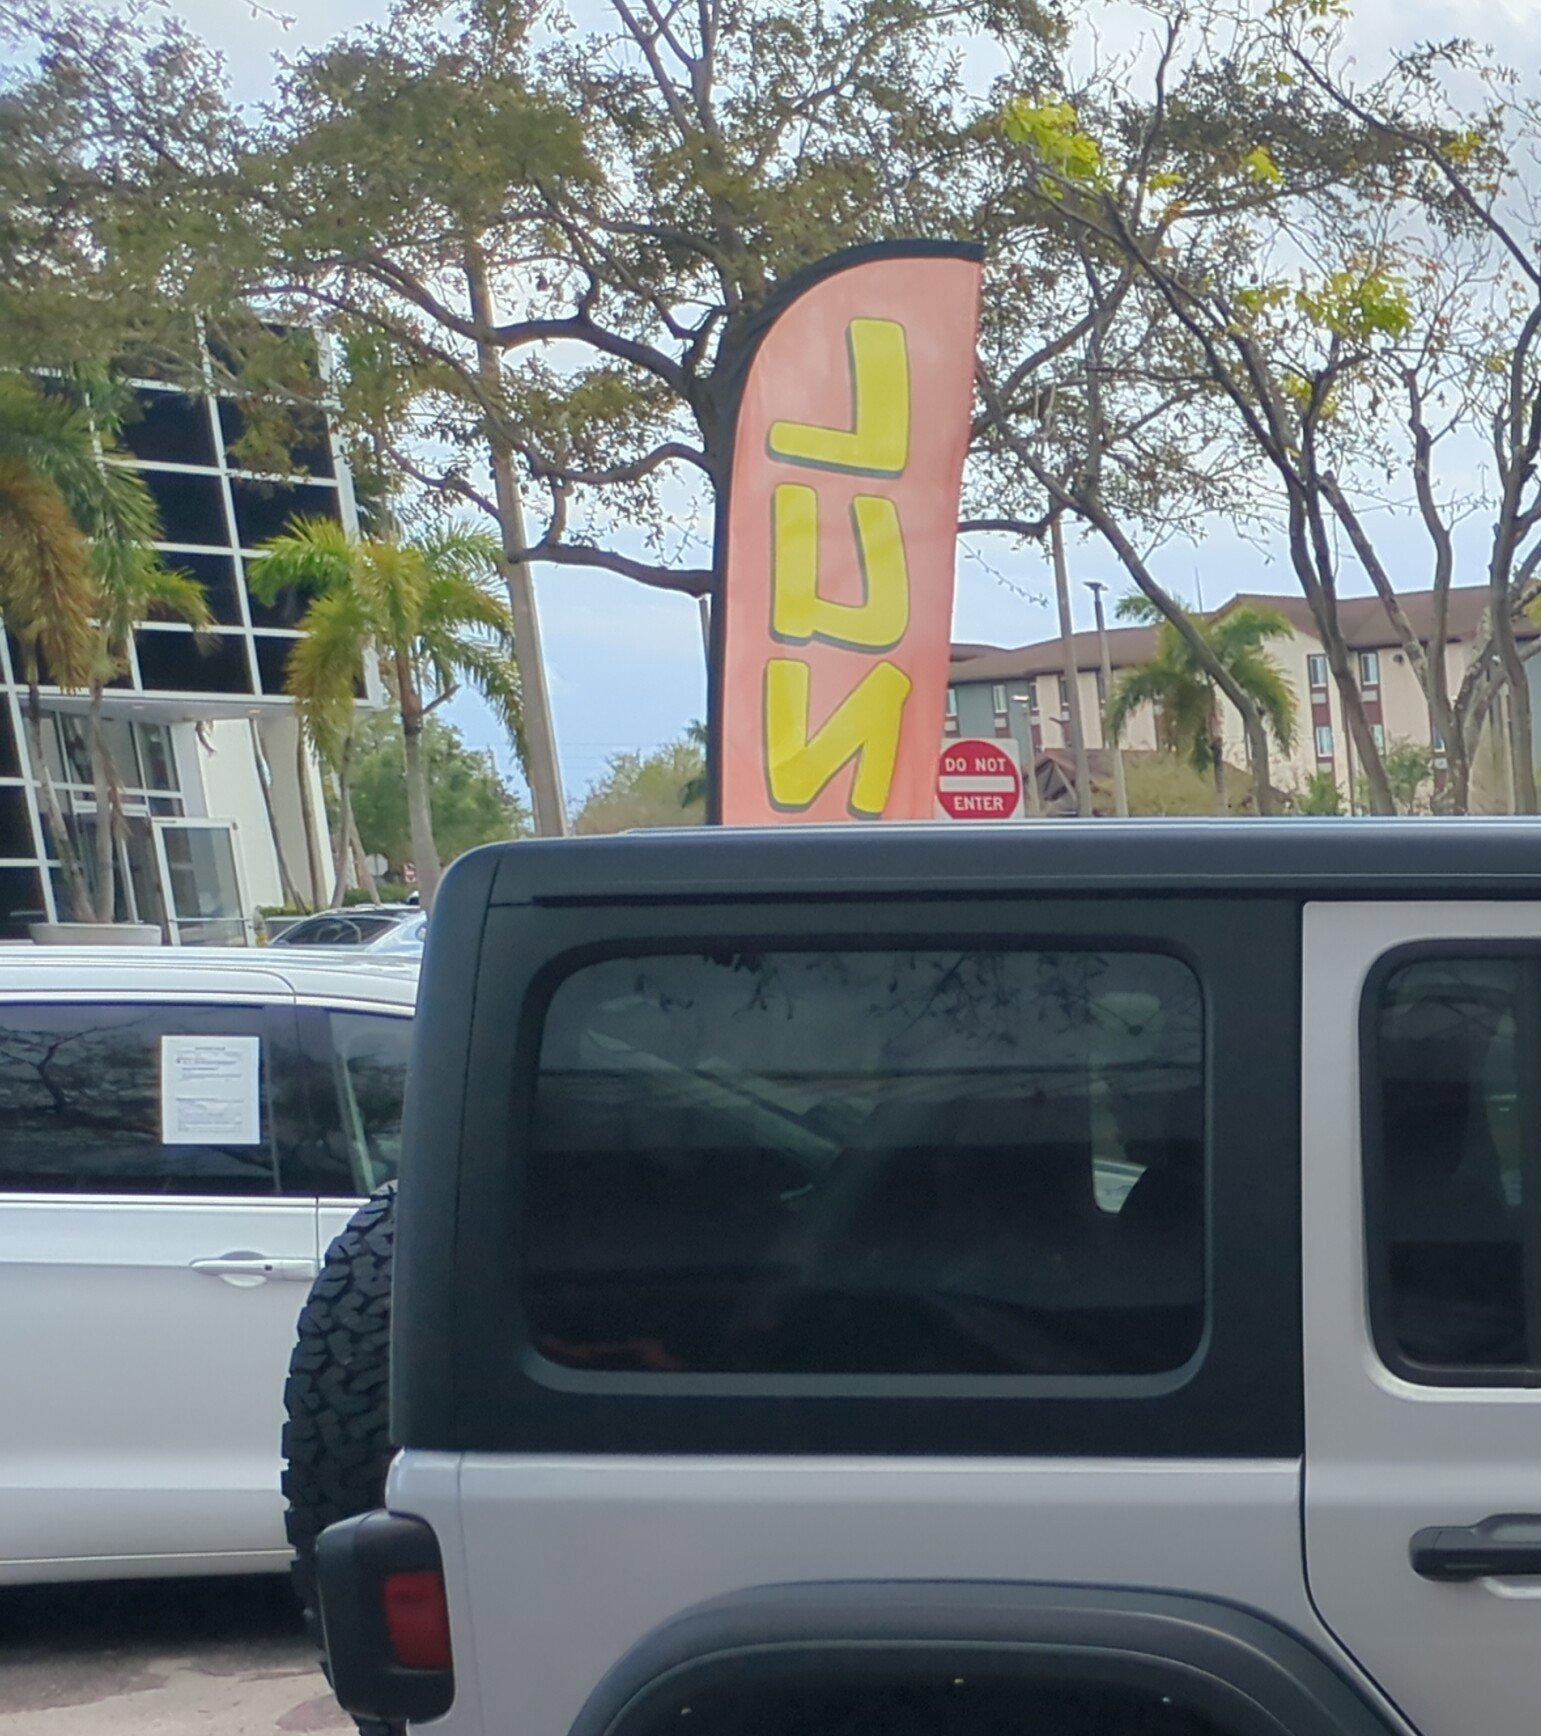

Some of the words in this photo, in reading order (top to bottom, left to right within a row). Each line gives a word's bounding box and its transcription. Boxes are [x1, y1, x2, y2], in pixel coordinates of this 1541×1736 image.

[945, 757, 967, 772] DO
[974, 757, 1006, 772] NOT
[953, 796, 1004, 811] ENTER
